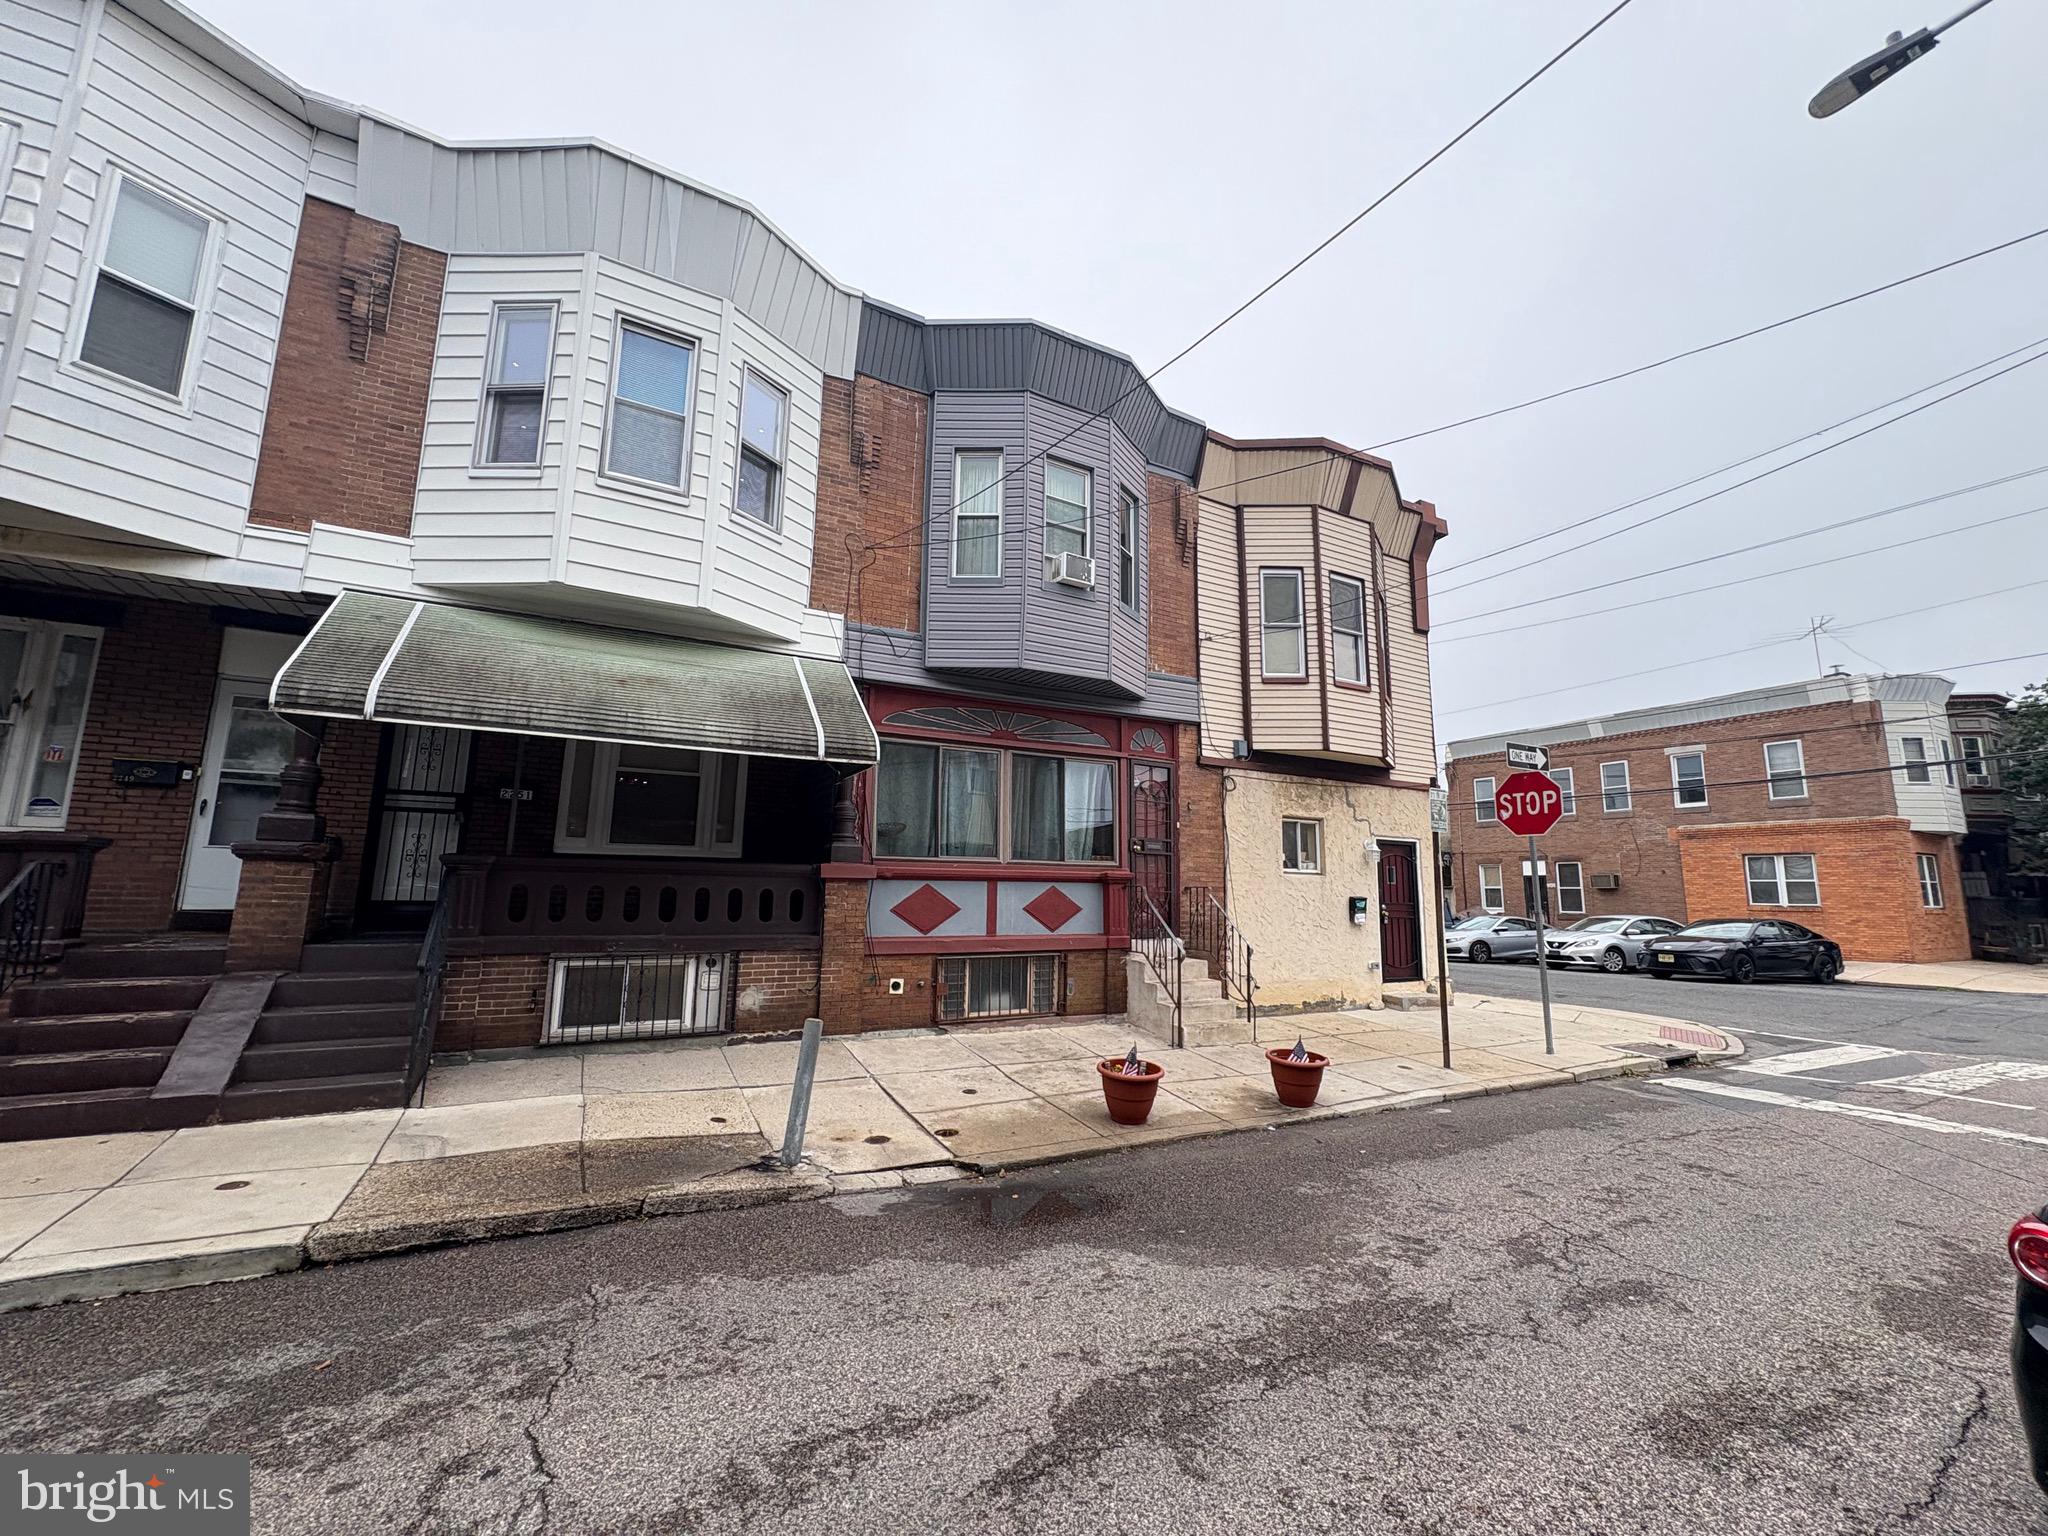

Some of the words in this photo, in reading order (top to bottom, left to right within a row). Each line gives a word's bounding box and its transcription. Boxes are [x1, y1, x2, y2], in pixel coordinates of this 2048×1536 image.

[1511, 751, 1524, 761] ONE
[1524, 752, 1537, 763] WAY
[1499, 790, 1558, 820] STOP
